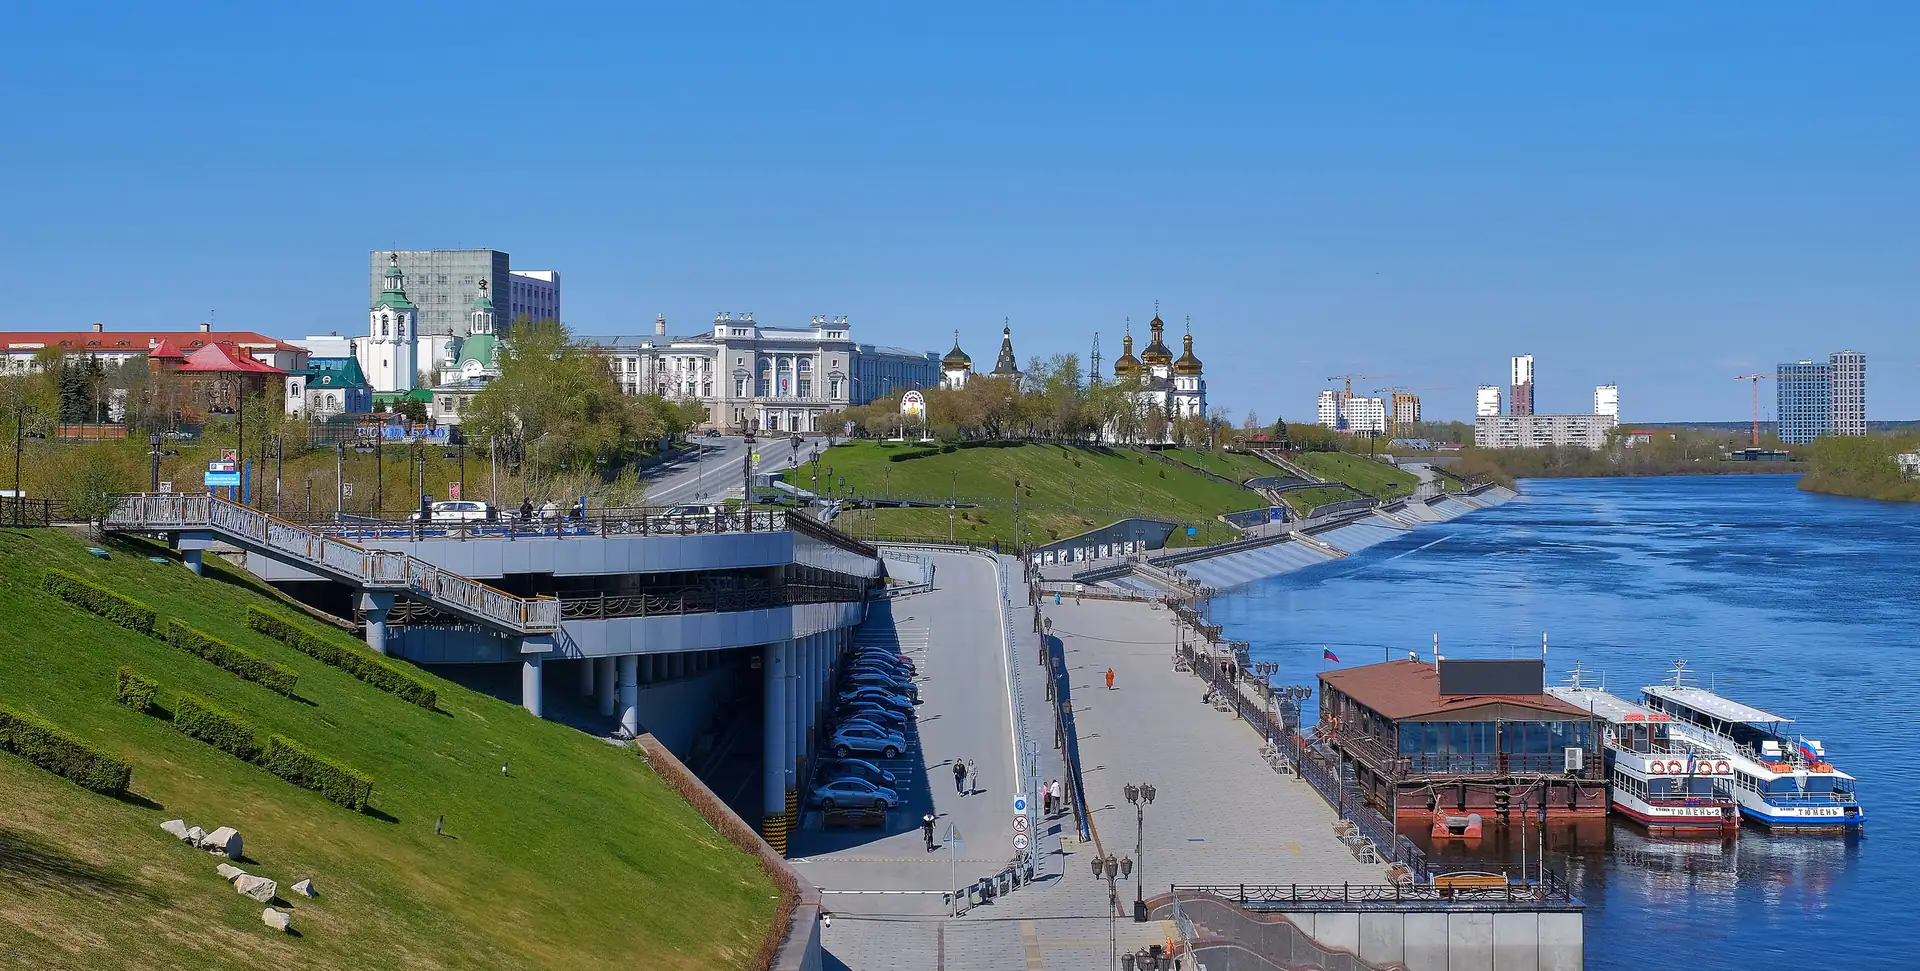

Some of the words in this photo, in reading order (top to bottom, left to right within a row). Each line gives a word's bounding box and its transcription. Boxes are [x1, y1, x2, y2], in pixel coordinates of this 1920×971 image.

[782, 378, 788, 391] 9
[1671, 808, 1720, 816] ТЮМЕНЬ-2
[1798, 808, 1838, 816] ТЮМЕНЬ
